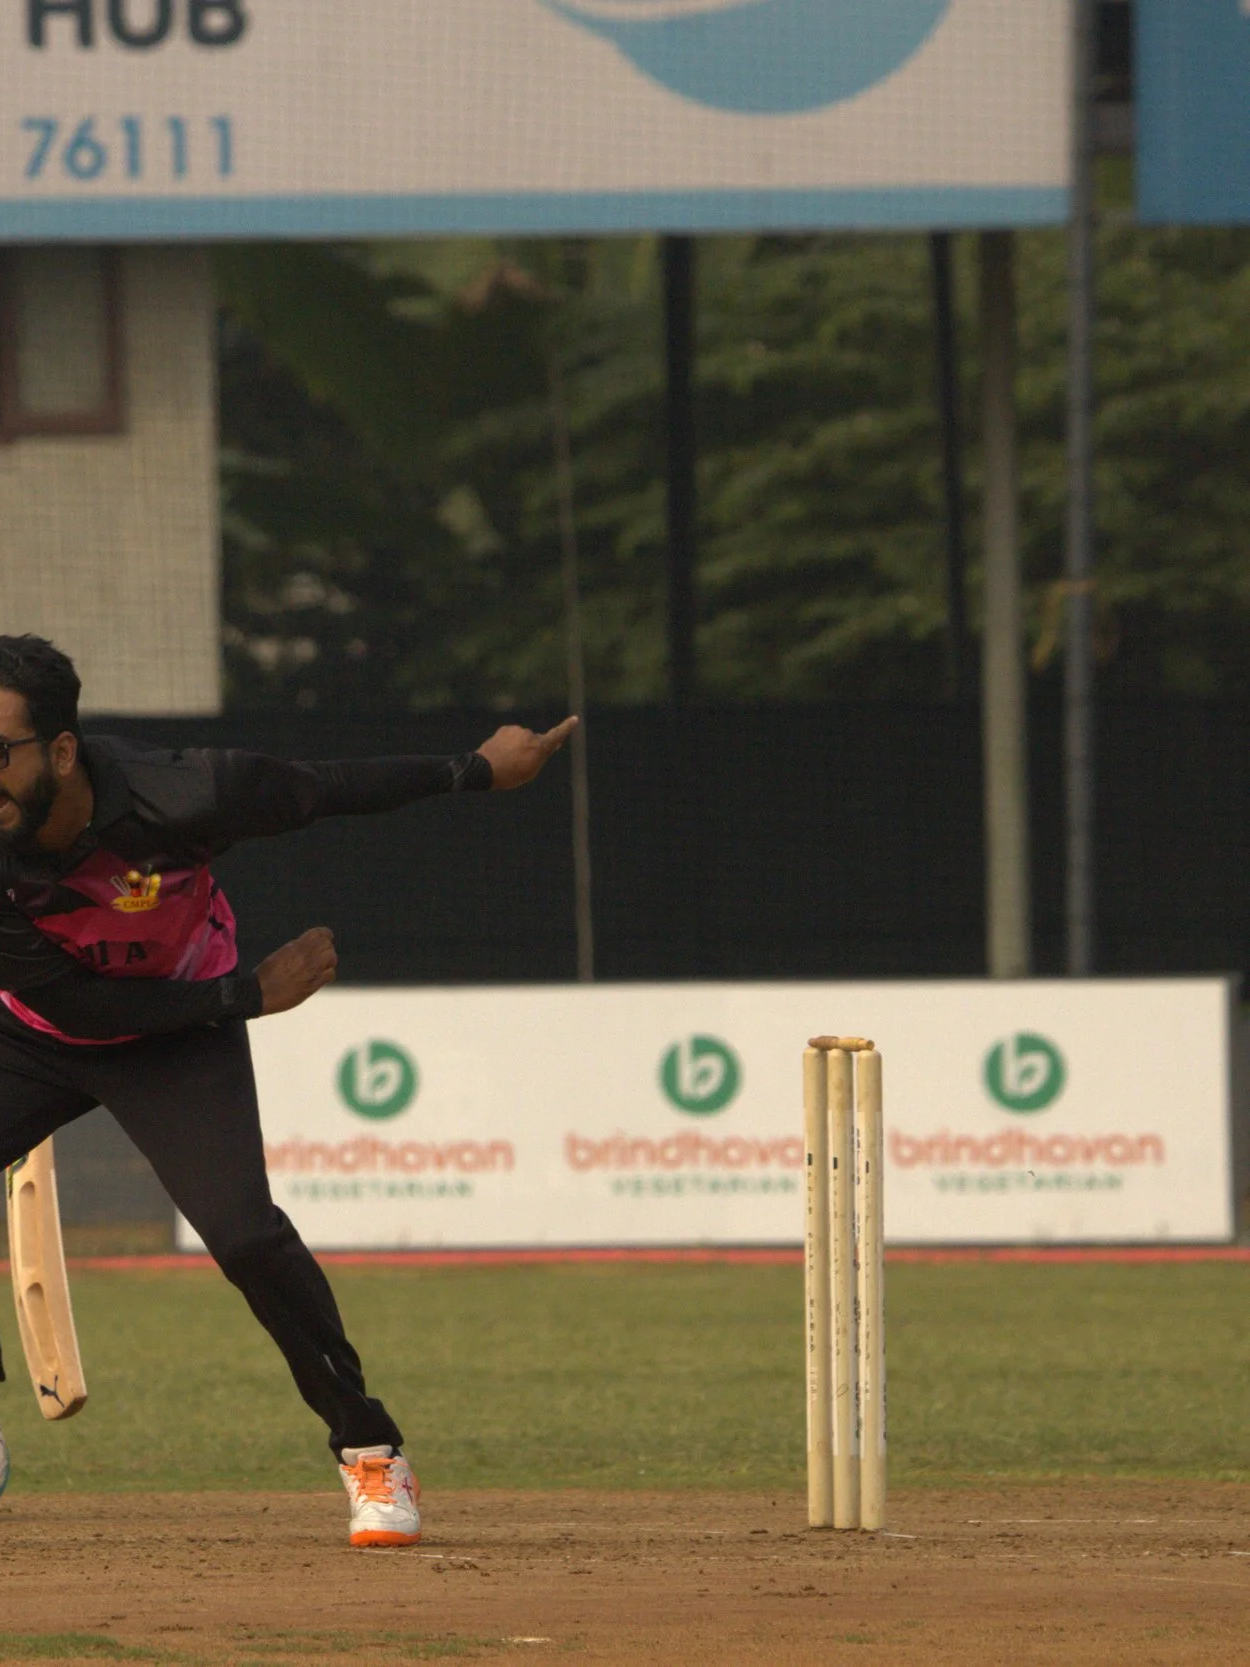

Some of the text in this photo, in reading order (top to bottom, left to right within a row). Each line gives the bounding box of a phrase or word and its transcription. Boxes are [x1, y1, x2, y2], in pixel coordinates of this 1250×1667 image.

[26, 0, 249, 50] HUB
[21, 113, 236, 180] 76111
[262, 1133, 516, 1175] rindhavan
[563, 1127, 806, 1173] brindhava
[886, 1125, 1166, 1171] brindhavan
